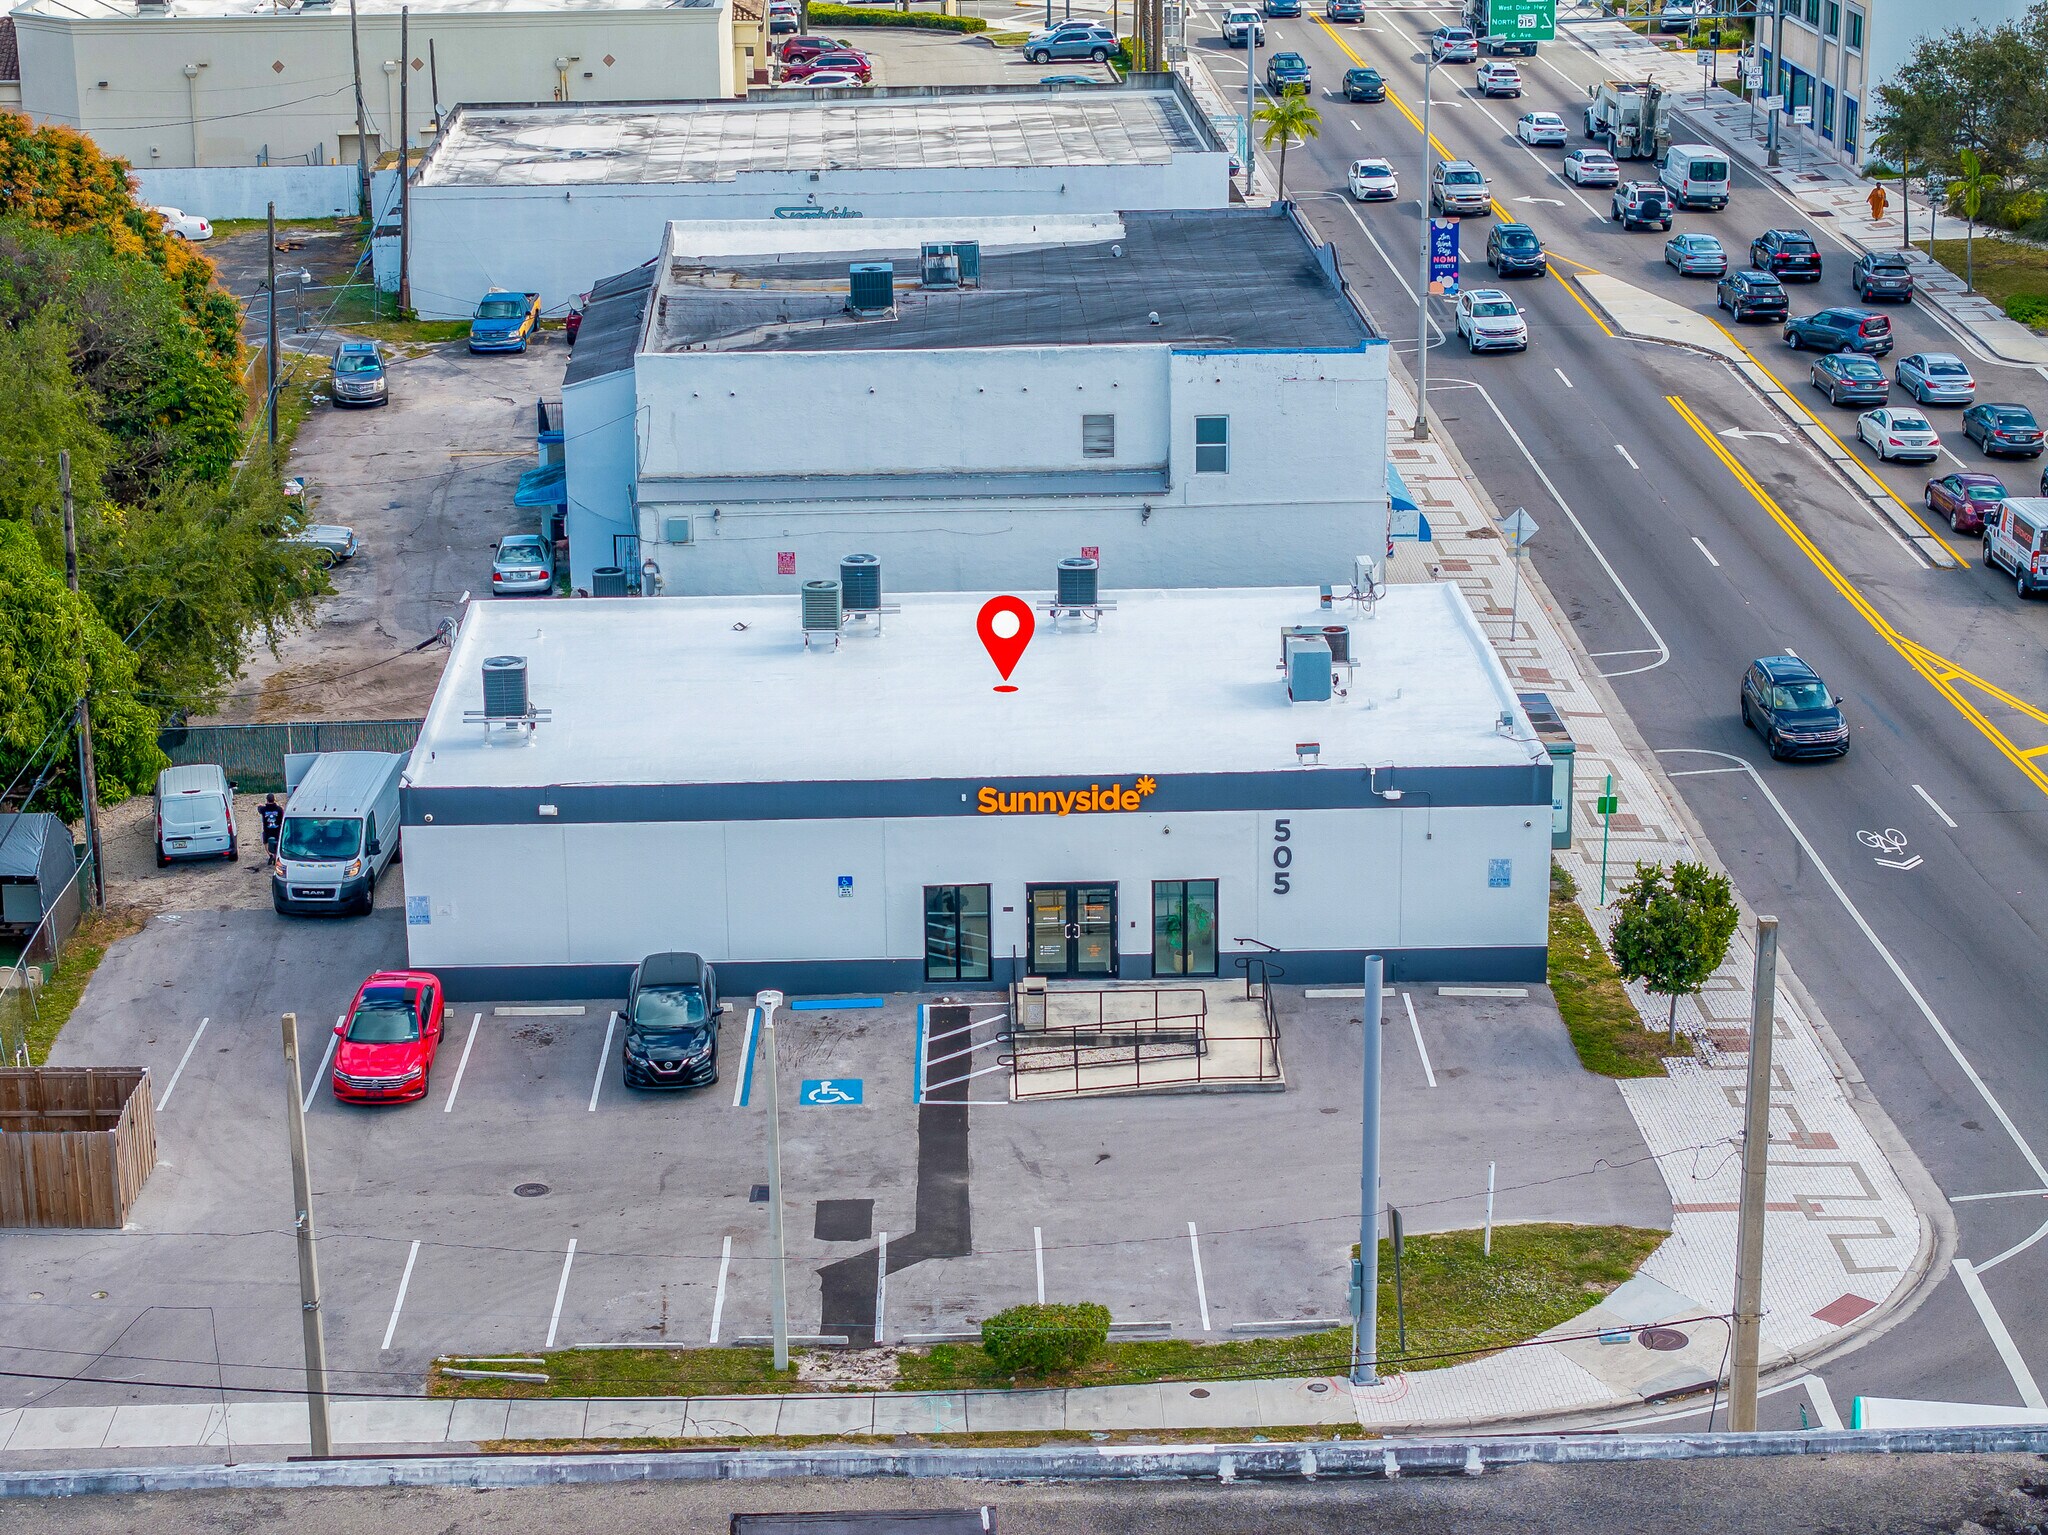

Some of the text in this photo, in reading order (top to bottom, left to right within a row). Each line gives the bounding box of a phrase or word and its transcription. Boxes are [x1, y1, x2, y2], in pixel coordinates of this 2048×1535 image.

[1492, 18, 1516, 26] NORTH
[1518, 19, 1533, 27] 915
[977, 783, 1140, 817] Sunnyside
